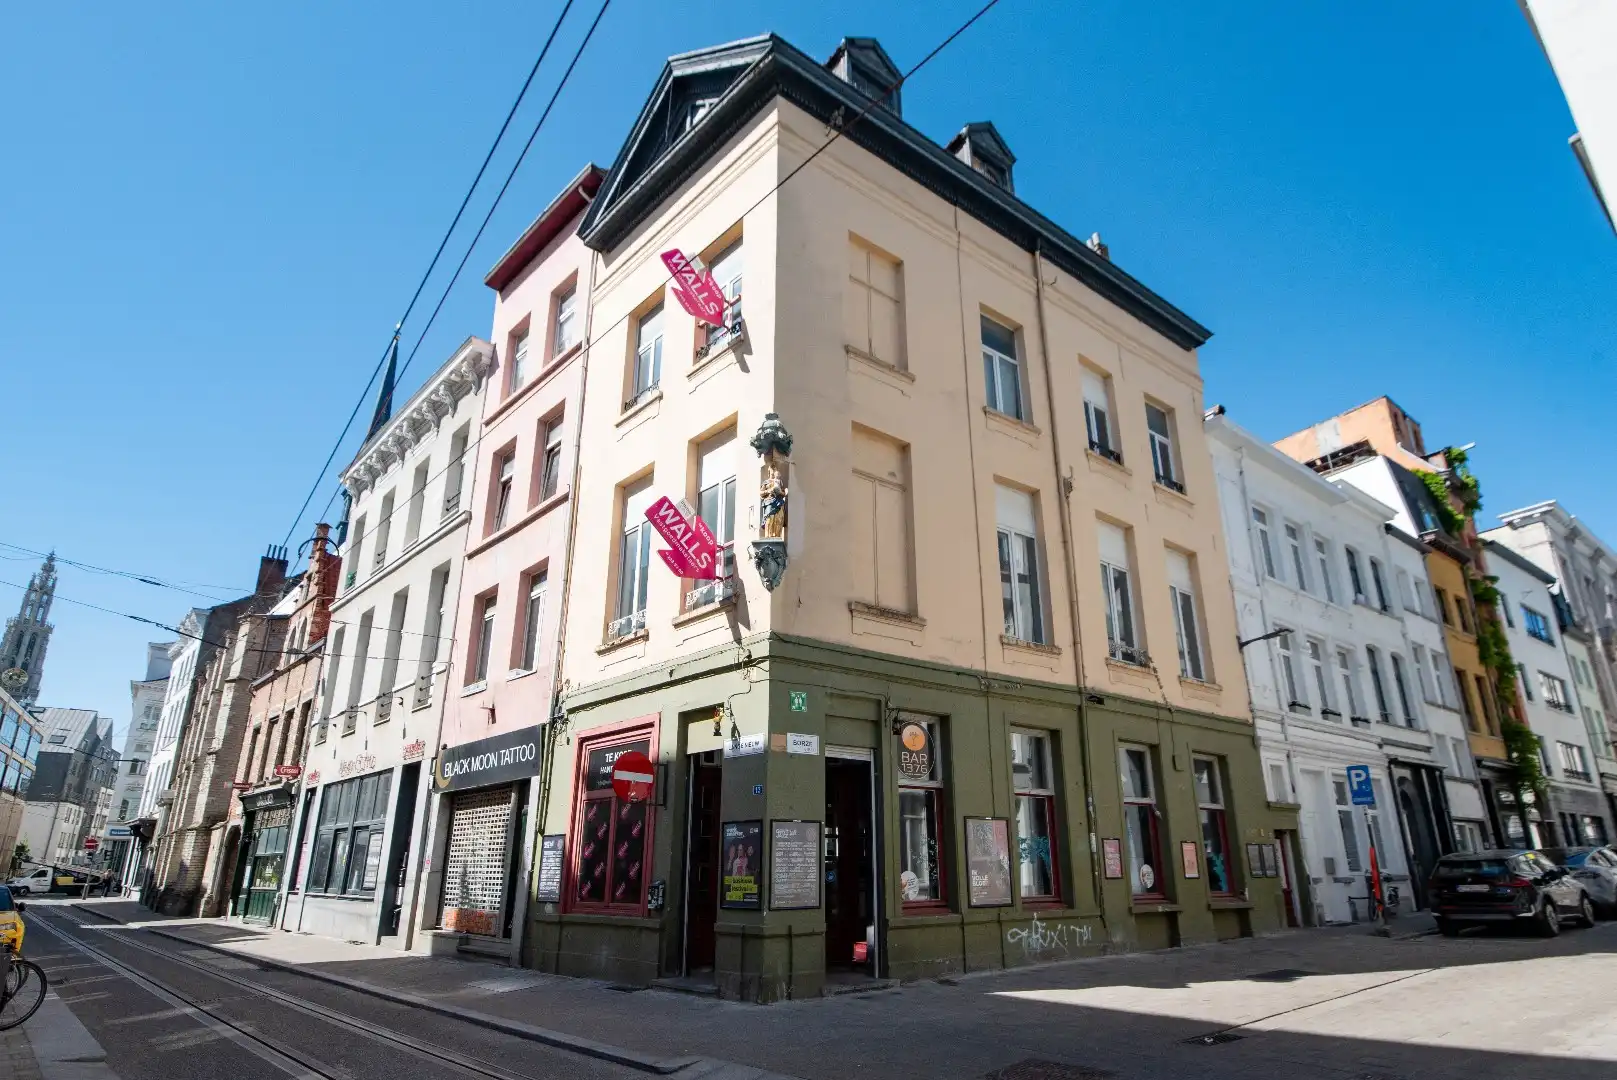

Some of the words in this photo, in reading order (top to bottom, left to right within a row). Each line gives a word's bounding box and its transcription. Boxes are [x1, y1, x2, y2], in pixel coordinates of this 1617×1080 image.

[671, 252, 719, 315] WALLS
[658, 501, 712, 569] WALLS
[444, 758, 470, 777] BLACK
[471, 751, 498, 772] MOON
[500, 743, 536, 766] TATTOO
[605, 752, 613, 763] TE
[901, 751, 928, 765] BAR
[901, 763, 928, 774] 1376
[1350, 769, 1367, 791] P
